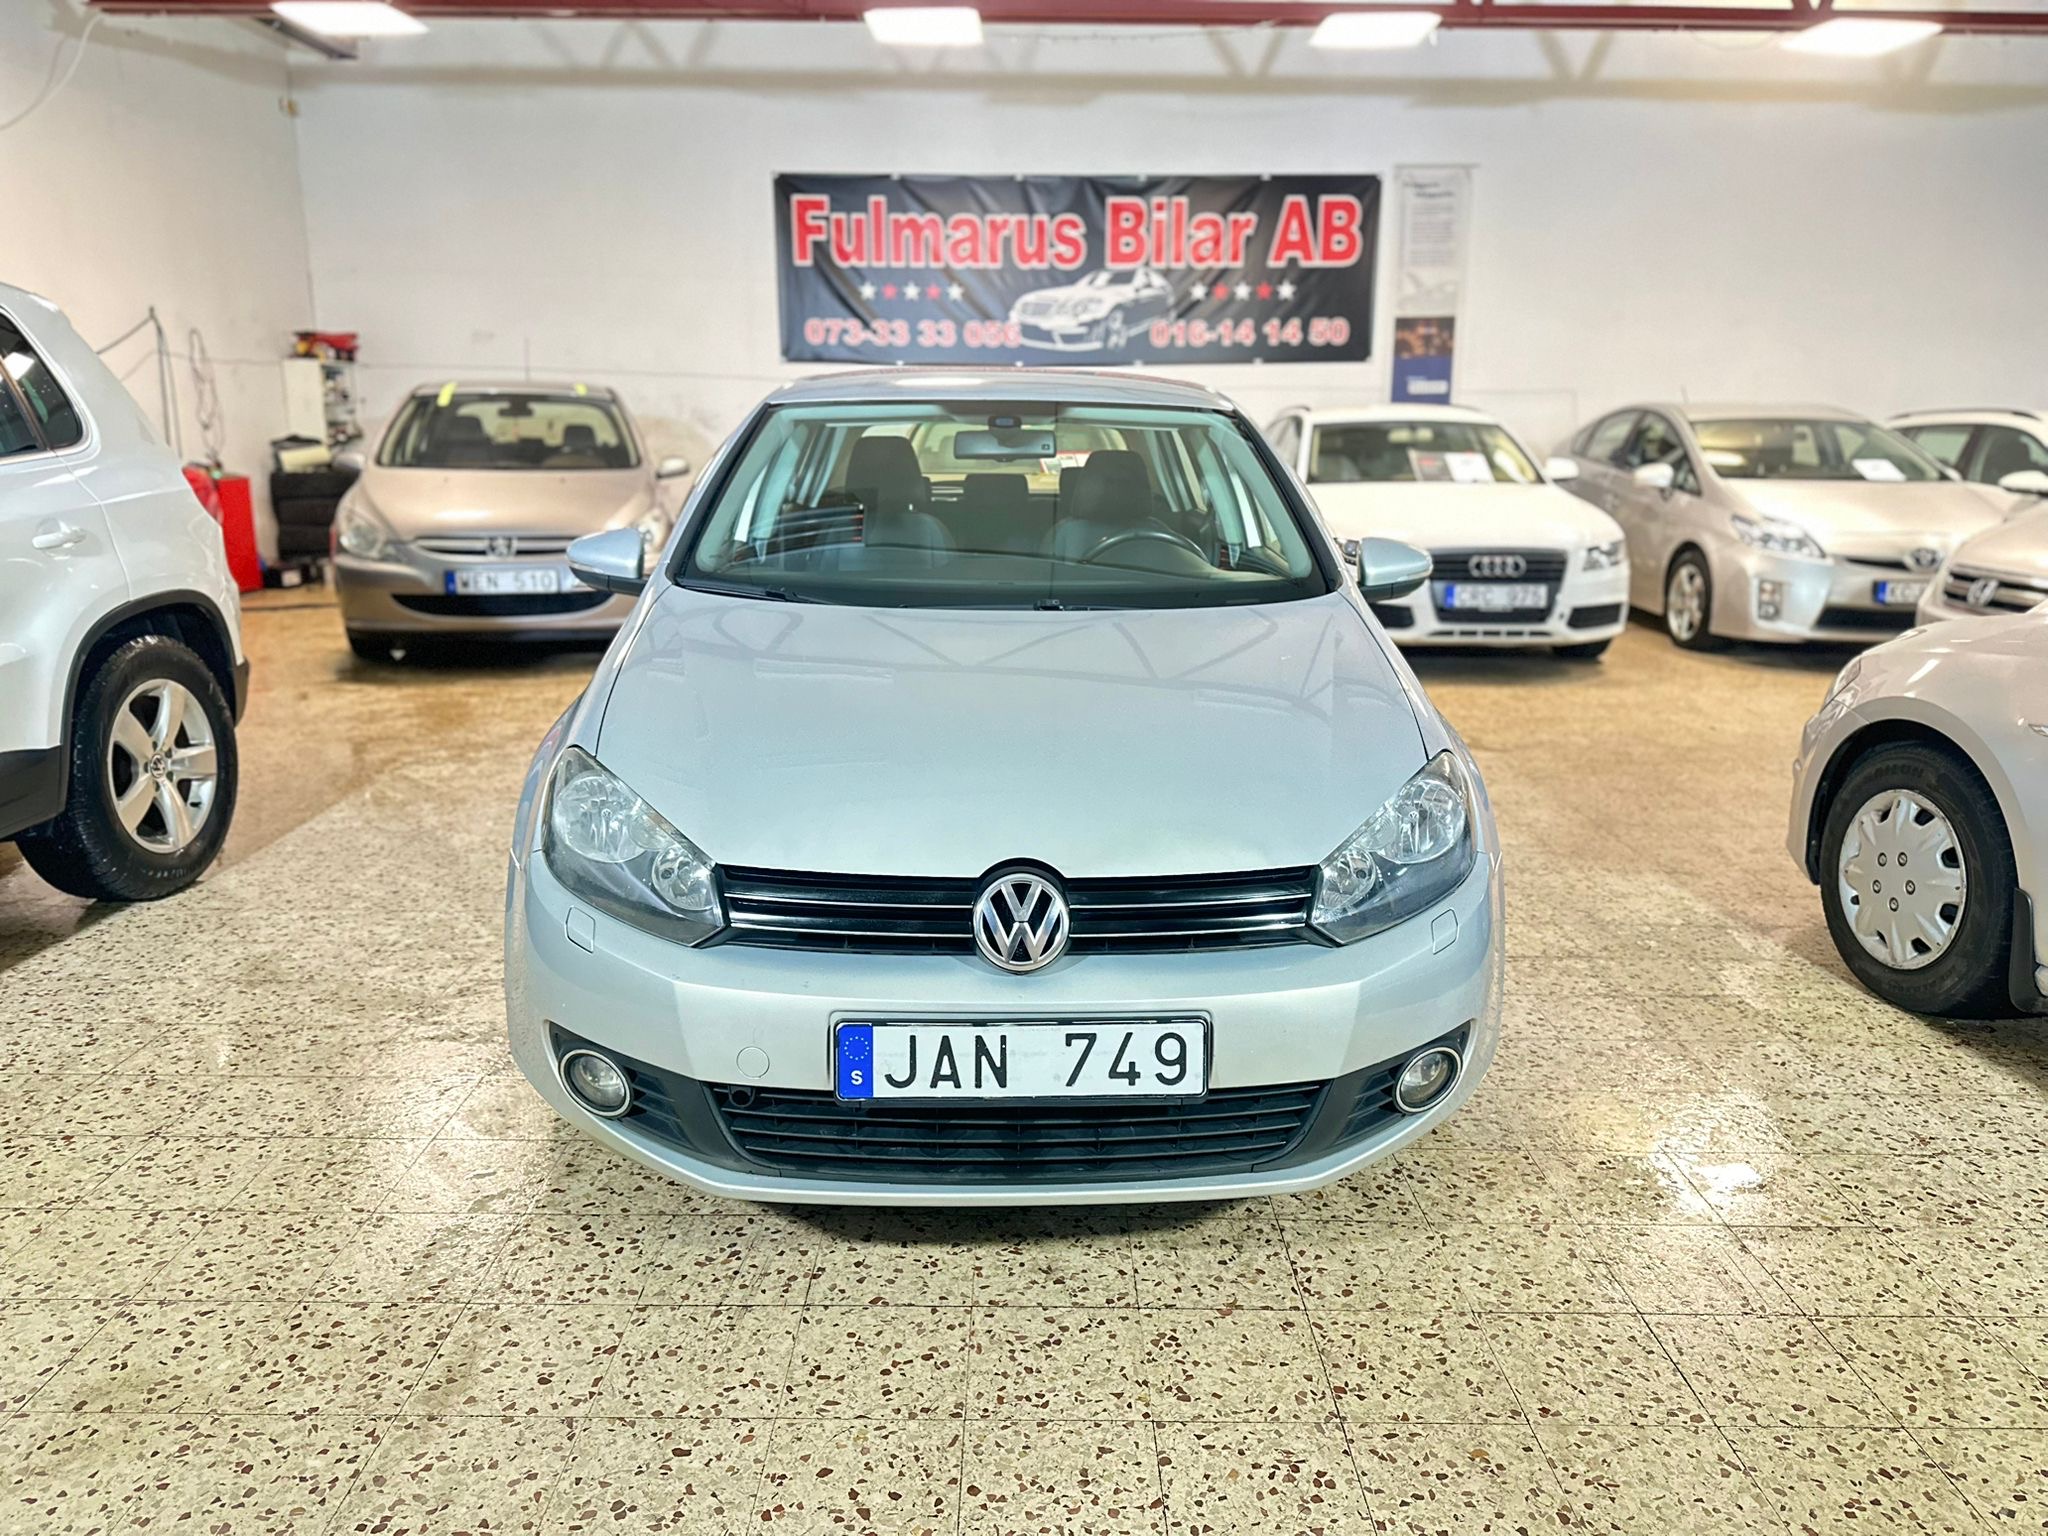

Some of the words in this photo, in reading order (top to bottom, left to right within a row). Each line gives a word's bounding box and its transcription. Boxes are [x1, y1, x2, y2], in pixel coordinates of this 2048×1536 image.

[790, 192, 1088, 270] Fulmarus
[1104, 193, 1258, 270] Bilar
[1266, 192, 1364, 269] AB
[803, 317, 911, 348] 073-33
[916, 318, 959, 349] 33
[1262, 316, 1304, 347] 14
[1307, 315, 1352, 347] 50
[882, 1033, 1009, 1090] JAN
[1064, 1031, 1188, 1088] 749
[849, 1069, 864, 1086] S
